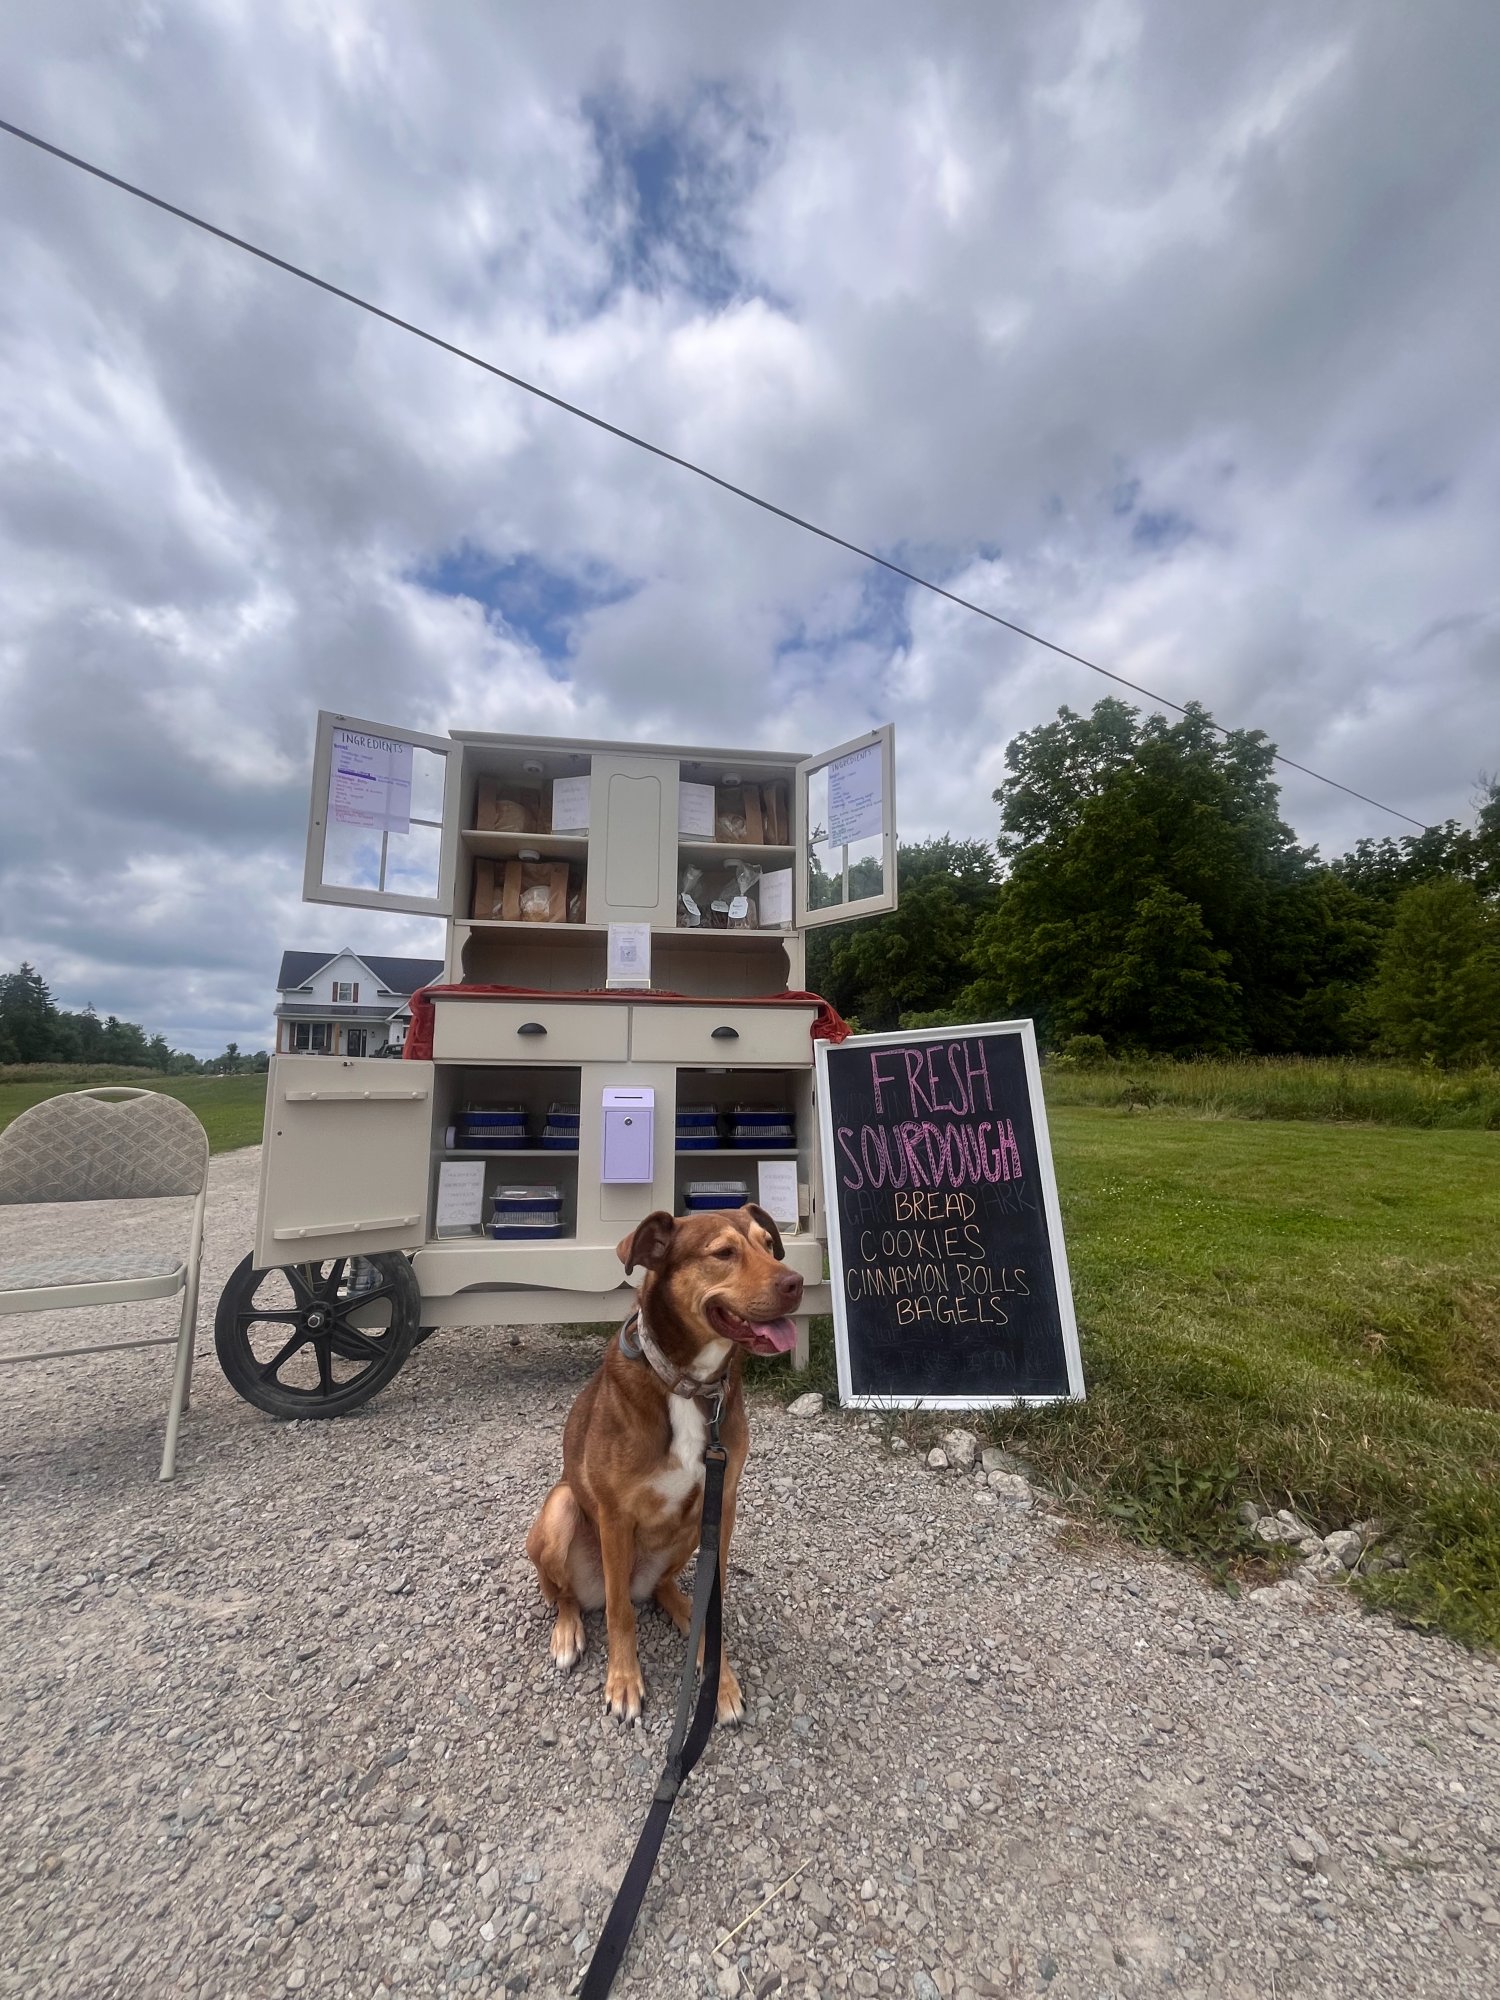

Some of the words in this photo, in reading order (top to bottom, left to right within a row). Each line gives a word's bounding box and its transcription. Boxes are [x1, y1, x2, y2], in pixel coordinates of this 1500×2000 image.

[341, 732, 403, 753] INGREDIENTS
[831, 749, 872, 772] INGREDIENTS
[870, 1039, 993, 1118] FRESH
[837, 1118, 1023, 1190] SOURDOUGH
[894, 1191, 976, 1222] BREAD
[860, 1224, 986, 1262] COOKIES
[847, 1263, 949, 1301] CINNAMON
[956, 1263, 1031, 1296] ROLLS
[896, 1295, 1009, 1326] BAGELS
